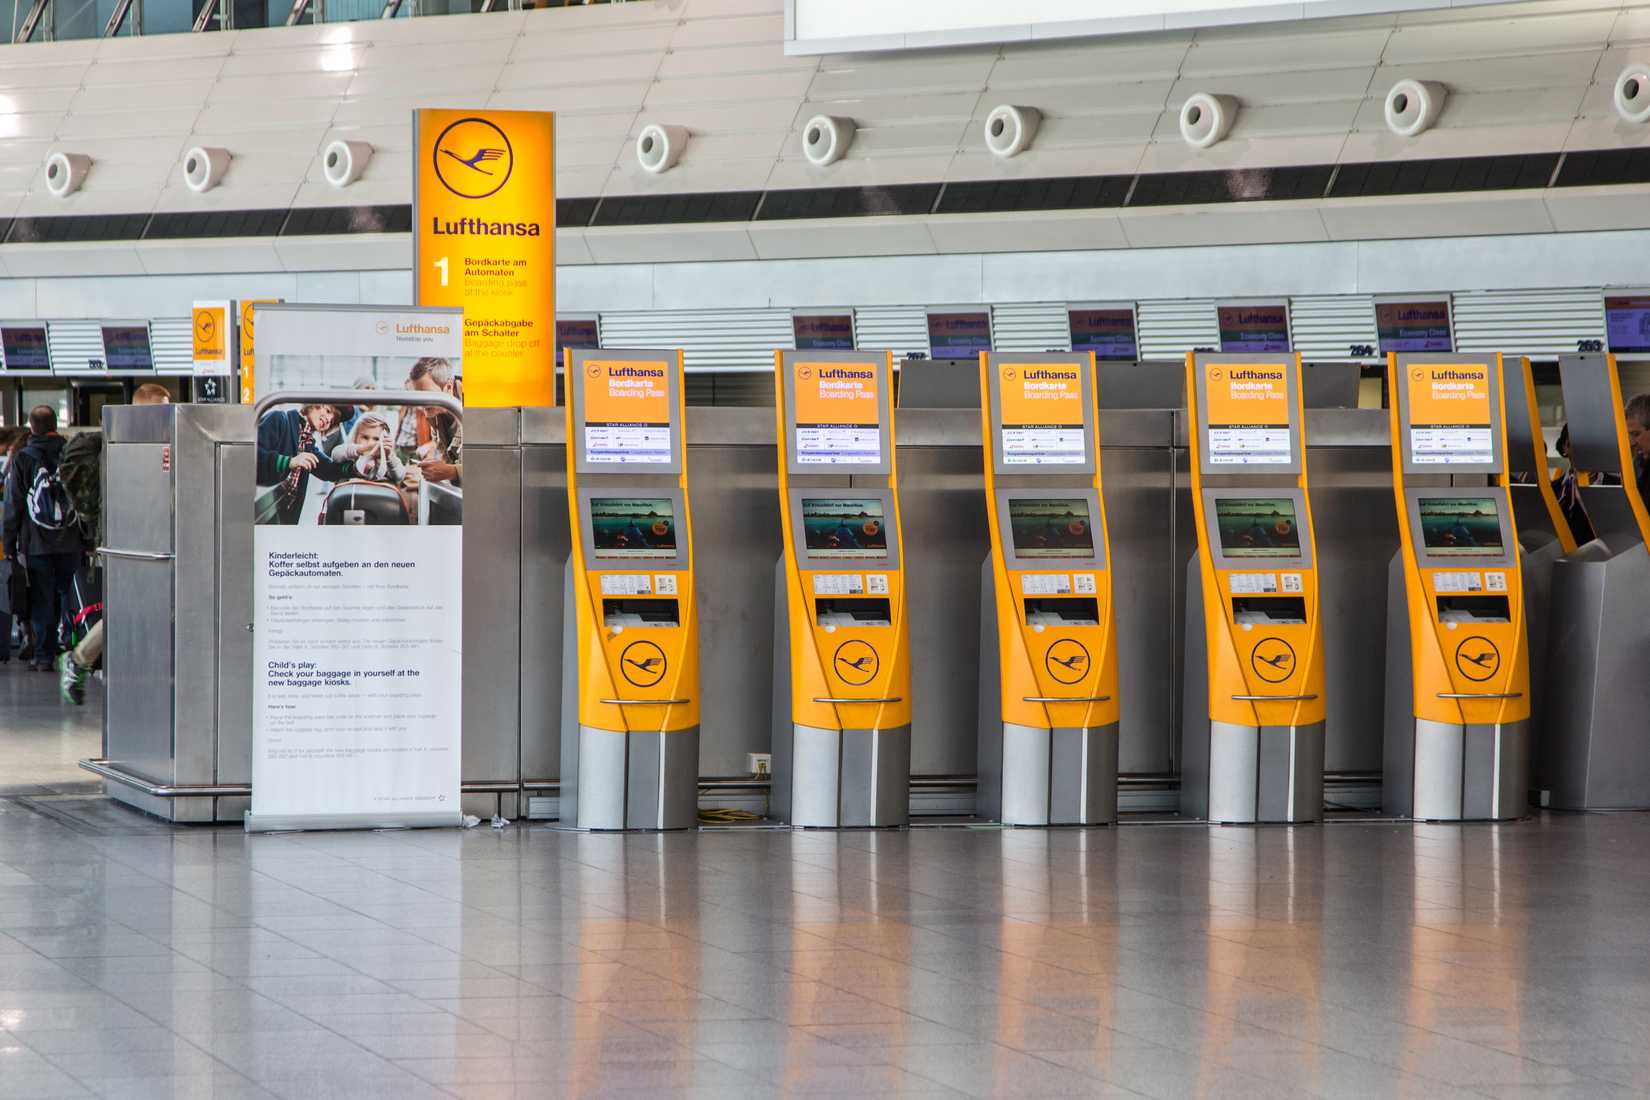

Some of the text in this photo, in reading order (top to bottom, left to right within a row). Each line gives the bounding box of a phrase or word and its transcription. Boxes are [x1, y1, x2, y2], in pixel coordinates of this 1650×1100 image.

[433, 216, 540, 236] Lufthansa
[464, 258, 510, 267] Bordkarte
[434, 256, 449, 286] 1
[464, 268, 514, 277] Automaten
[464, 278, 504, 288] Boarding
[475, 288, 489, 296] the
[1398, 310, 1446, 320] Lufthansa
[464, 318, 534, 328] Gepäckabgabe
[396, 323, 449, 334] Lufthansa
[482, 328, 520, 338] Schalter
[464, 339, 540, 350] Baggage drop off
[1577, 340, 1602, 352] 263
[475, 349, 489, 357] the
[244, 367, 249, 379] 1
[609, 367, 663, 377] Lufthansa
[819, 369, 872, 378] Lufthansa
[1024, 370, 1076, 379] Lufthansa
[1230, 370, 1282, 380] Lufthansa
[1432, 370, 1483, 380] Lufthansa
[244, 388, 250, 401] 2
[322, 560, 358, 570] aufgeben
[269, 569, 343, 577] Gepäckautomaten.
[298, 661, 317, 671] play:
[296, 671, 313, 679] your
[316, 670, 351, 679] baggage
[363, 670, 395, 679] yourself
[287, 679, 322, 688] baggage
